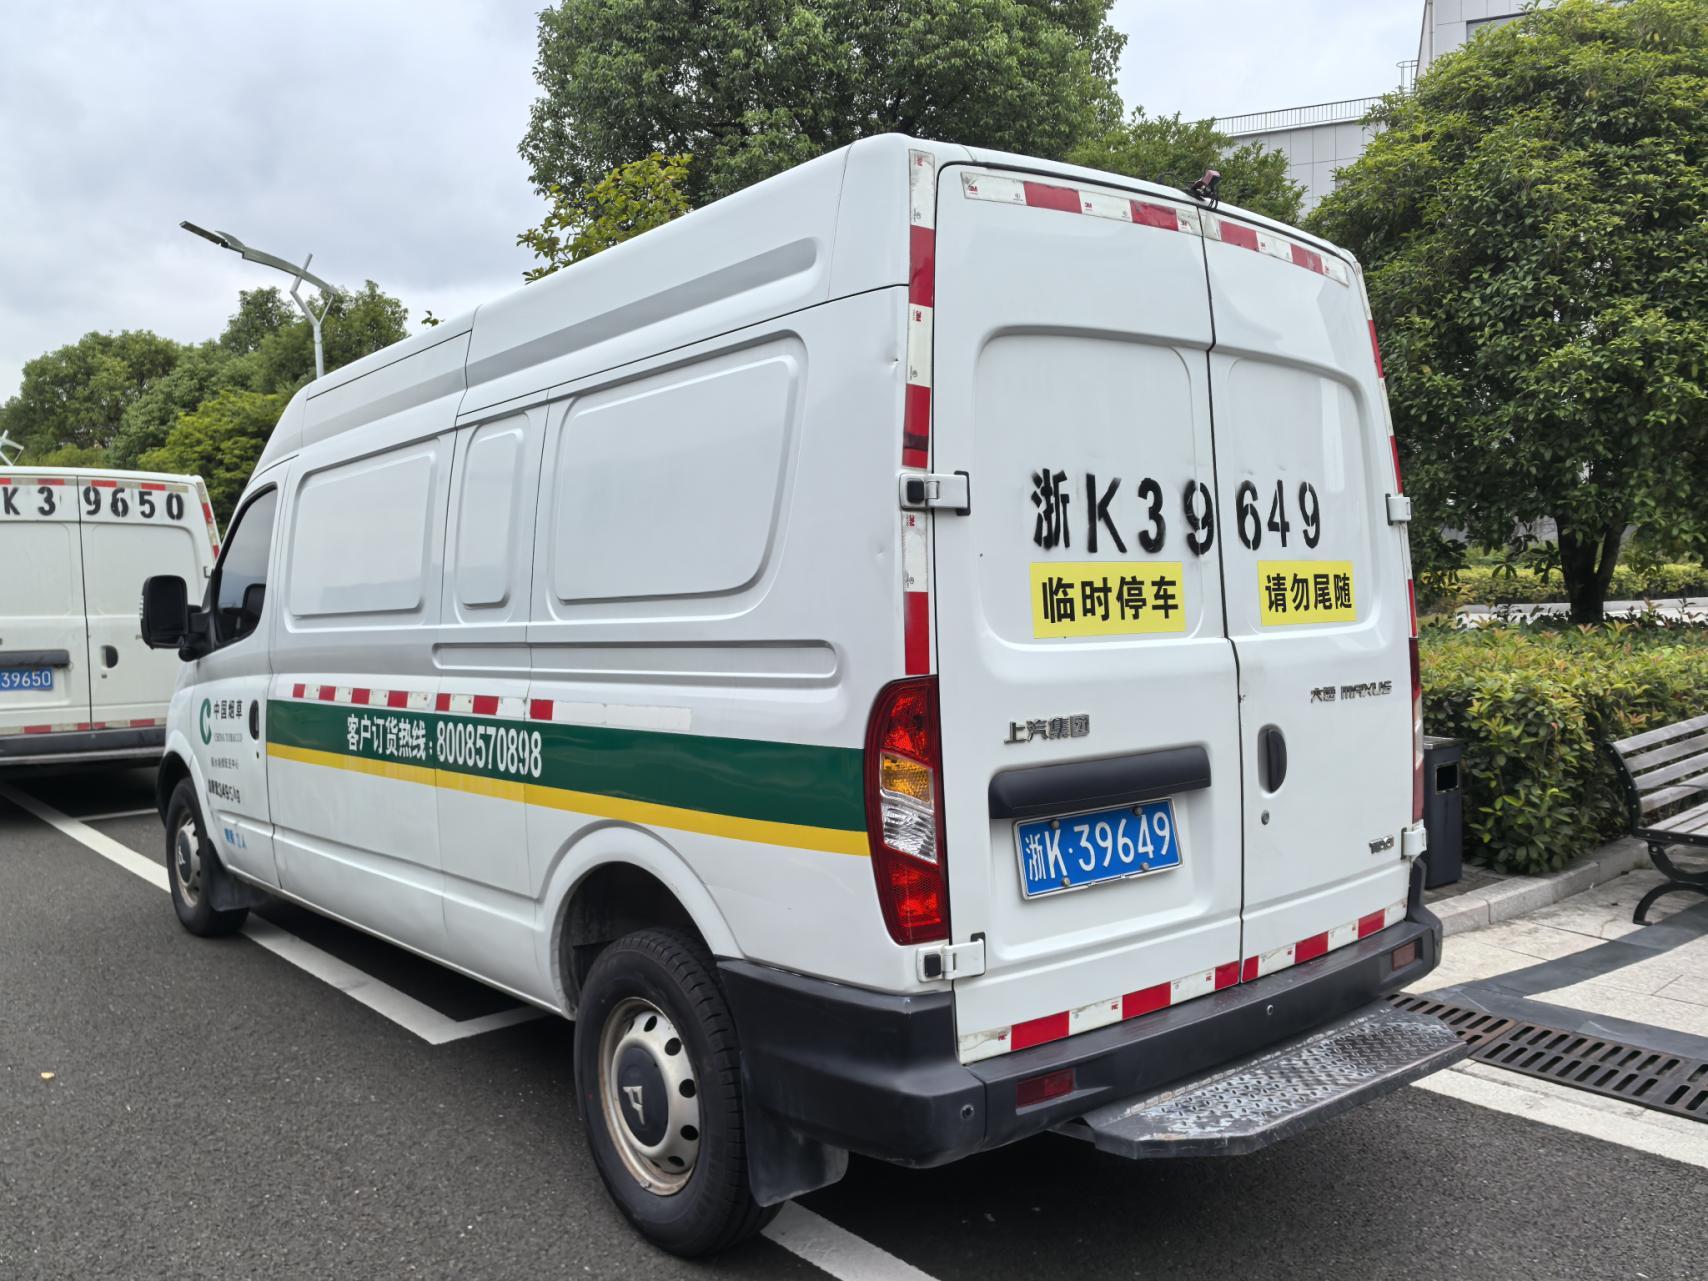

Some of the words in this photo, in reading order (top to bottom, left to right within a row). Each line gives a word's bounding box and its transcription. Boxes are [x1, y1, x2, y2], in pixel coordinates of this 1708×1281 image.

[1031, 468, 1321, 556] 浙K39649
[1041, 576, 1179, 624] 临时停车
[1264, 572, 1353, 613] 请勿尾随
[0, 671, 51, 688] 39650
[1004, 714, 1090, 745] 上汽集团
[1025, 811, 1171, 882] 浙K·39649
